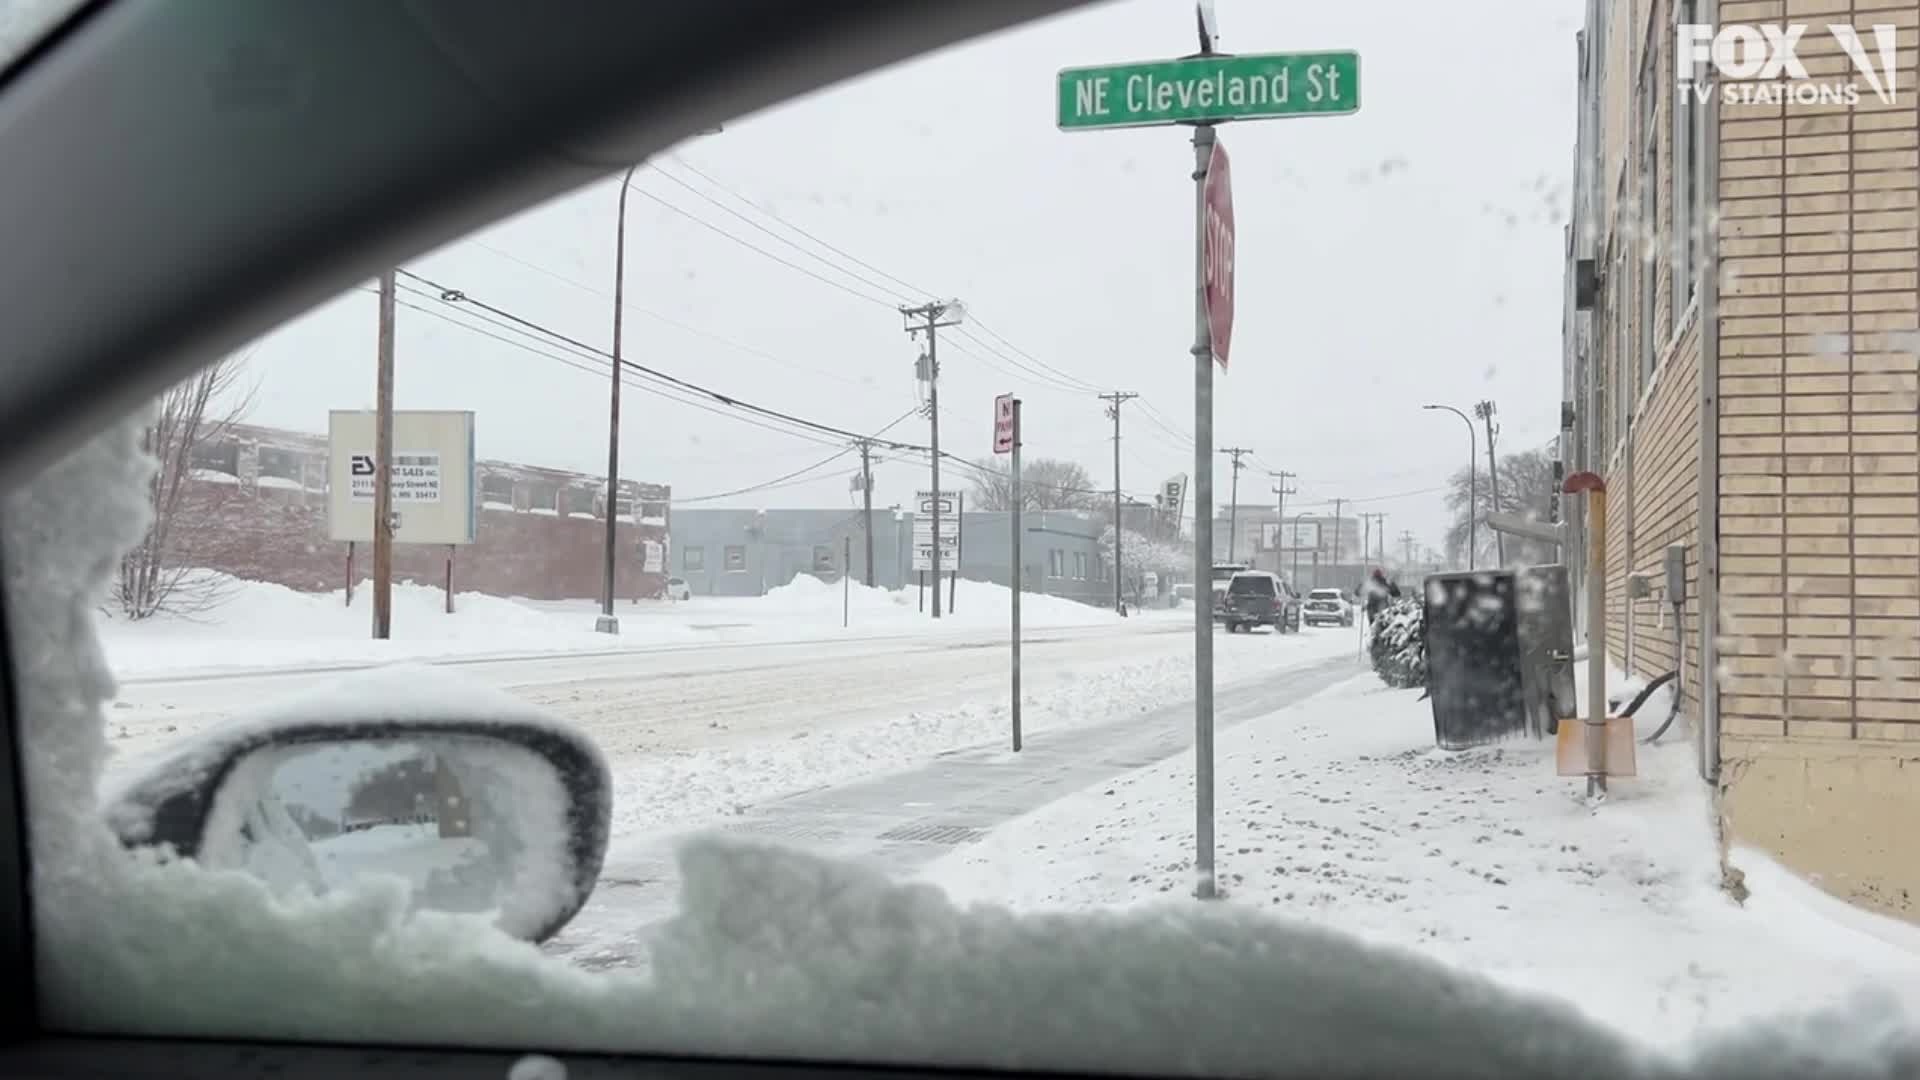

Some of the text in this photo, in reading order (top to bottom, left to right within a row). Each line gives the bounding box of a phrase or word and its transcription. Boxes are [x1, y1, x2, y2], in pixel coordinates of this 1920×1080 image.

[1075, 64, 1341, 117] NE Cleveland St
[1206, 202, 1233, 302] STOP
